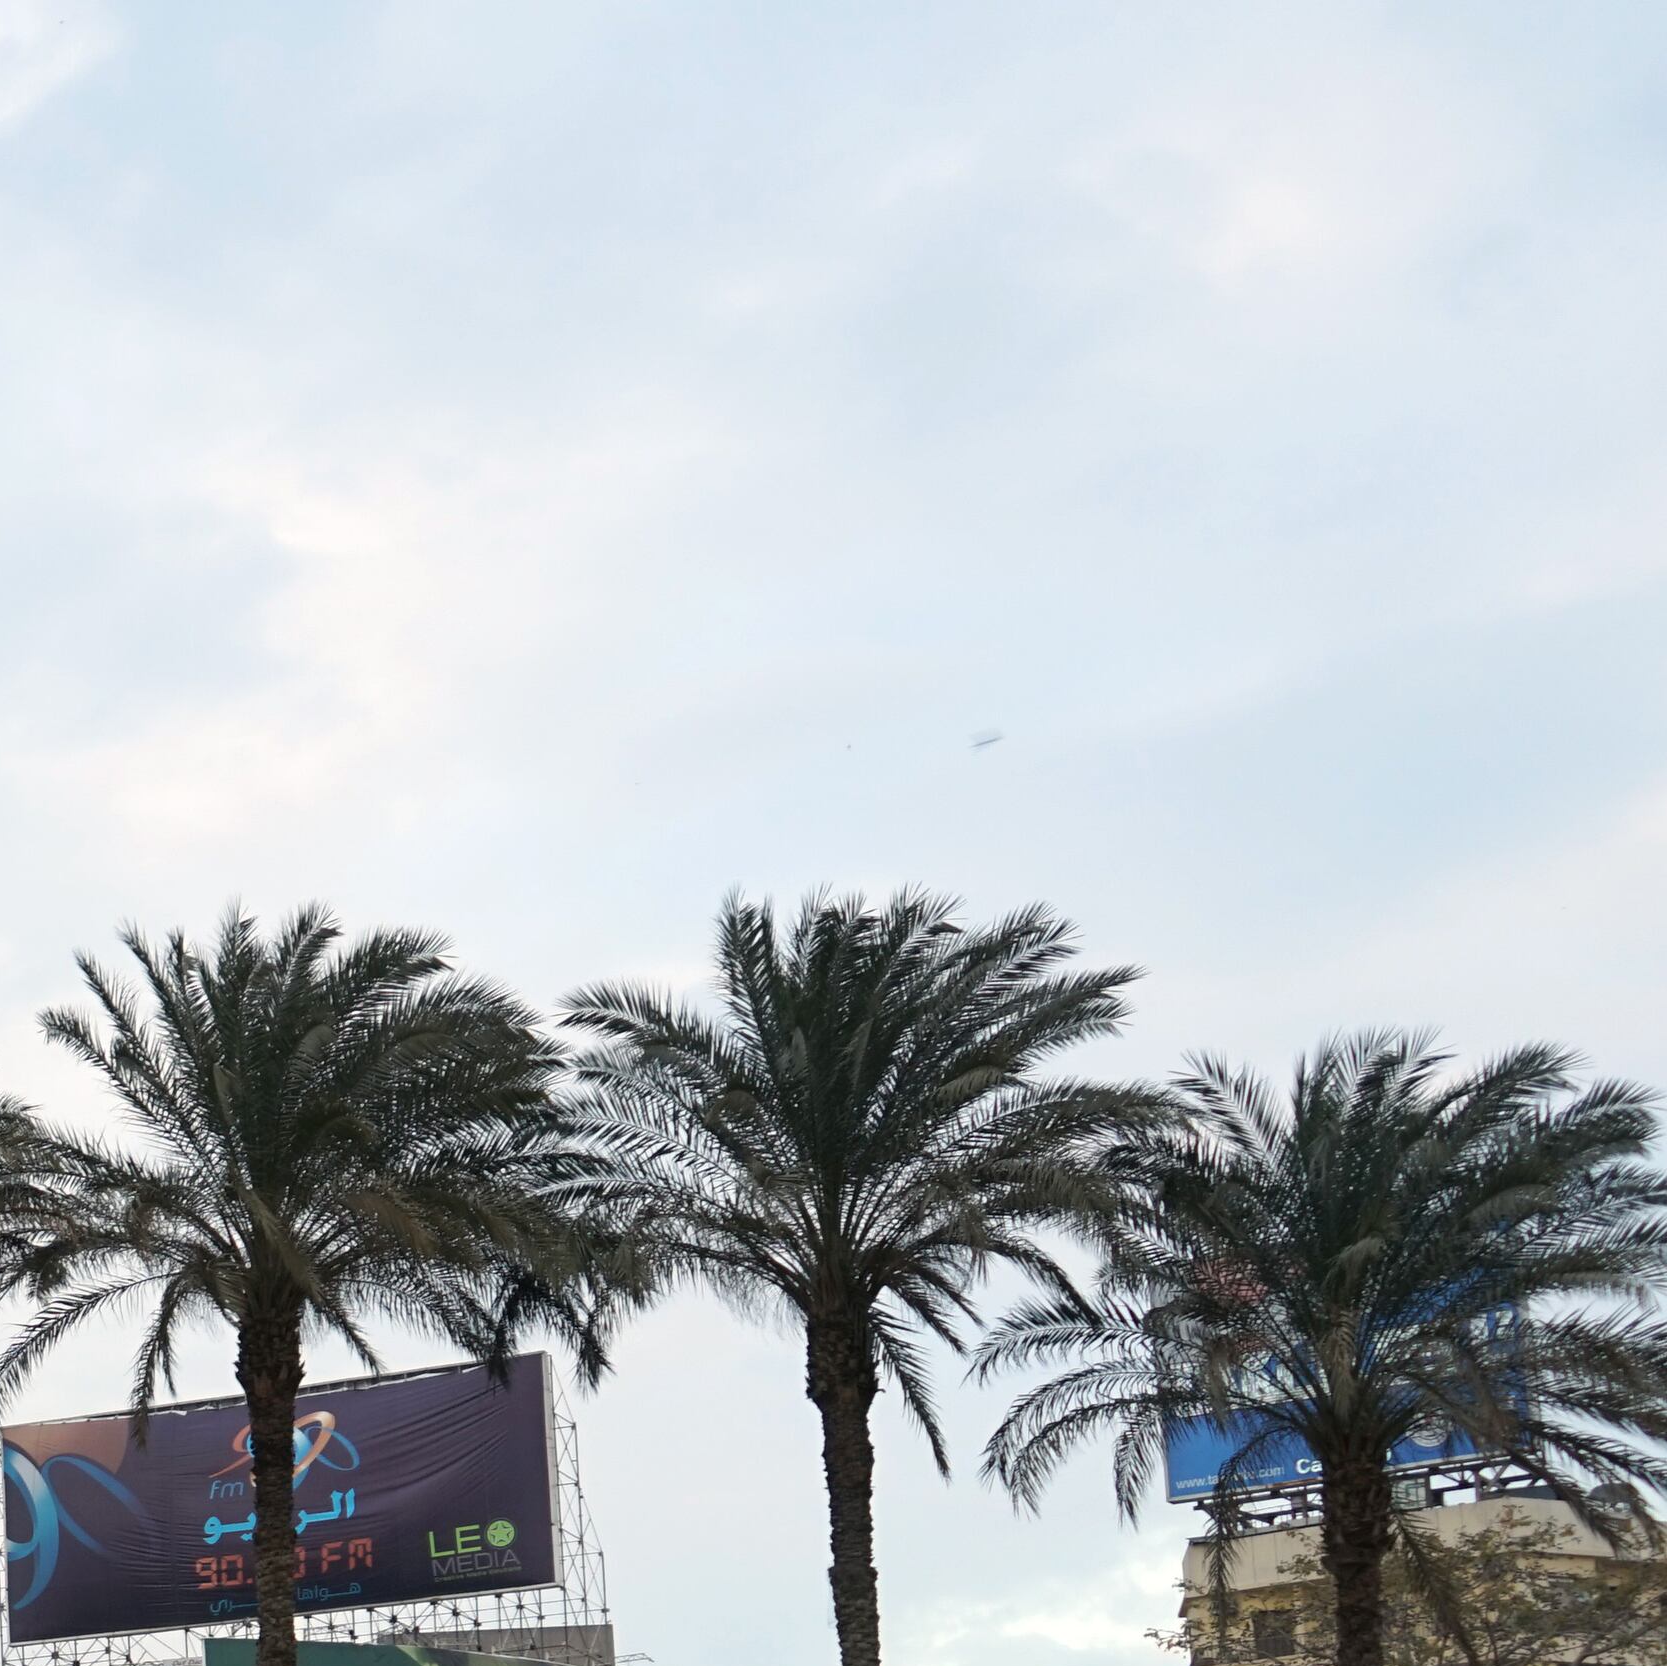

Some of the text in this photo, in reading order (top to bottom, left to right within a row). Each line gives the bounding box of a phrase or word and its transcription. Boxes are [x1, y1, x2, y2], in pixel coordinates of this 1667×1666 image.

[202, 1487, 356, 1545] الريو
[320, 1537, 374, 1574] FM
[428, 1519, 516, 1558] LEO
[431, 1549, 522, 1577] MEDIA
